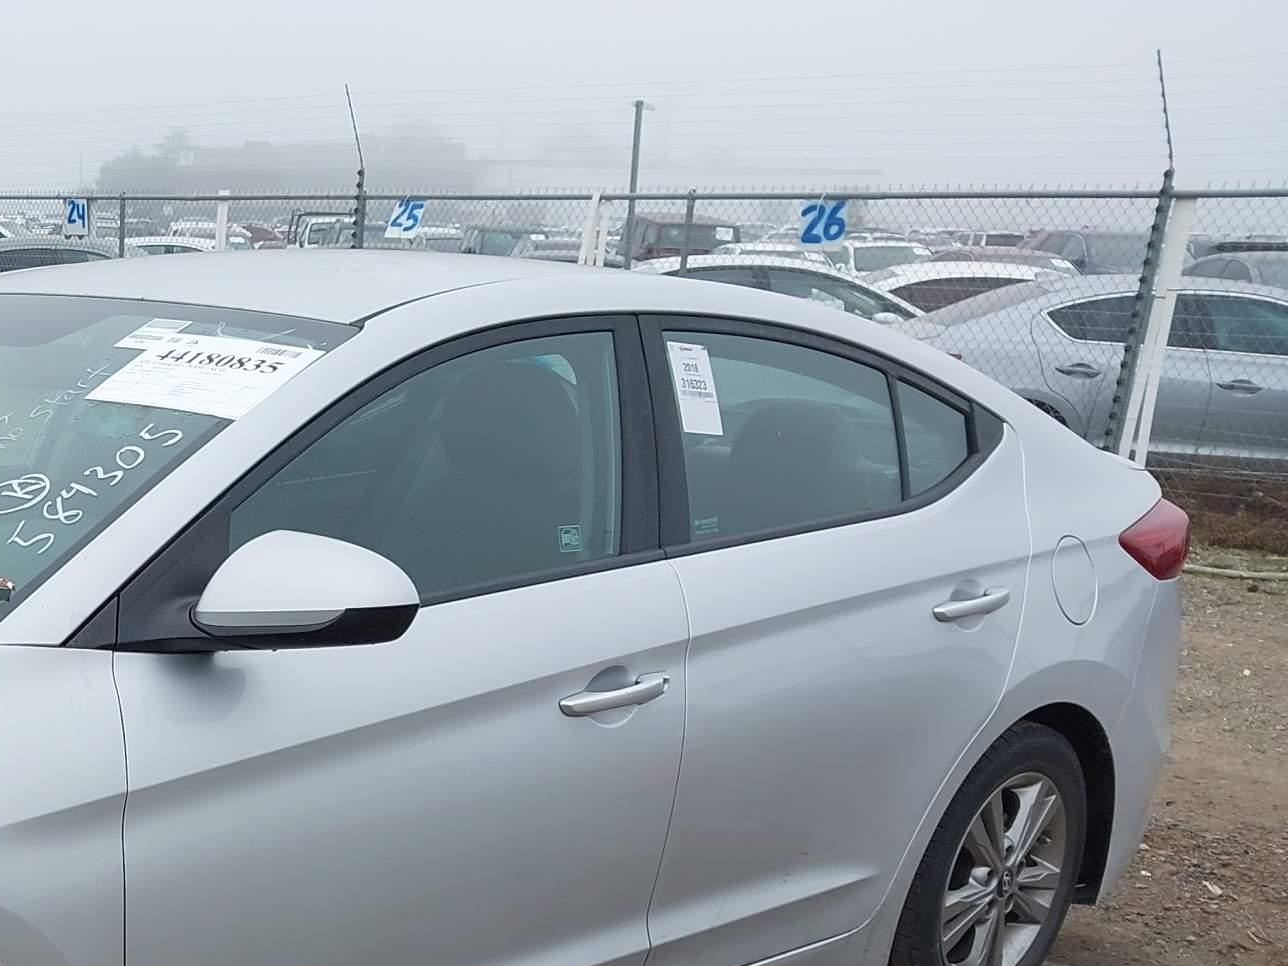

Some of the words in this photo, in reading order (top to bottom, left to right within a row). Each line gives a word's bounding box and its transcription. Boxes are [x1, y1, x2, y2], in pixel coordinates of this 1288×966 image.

[67, 200, 86, 229] 24
[390, 198, 424, 232] 25
[801, 200, 846, 244] 26
[156, 349, 286, 375] 44180835
[7, 423, 184, 554] 584305
